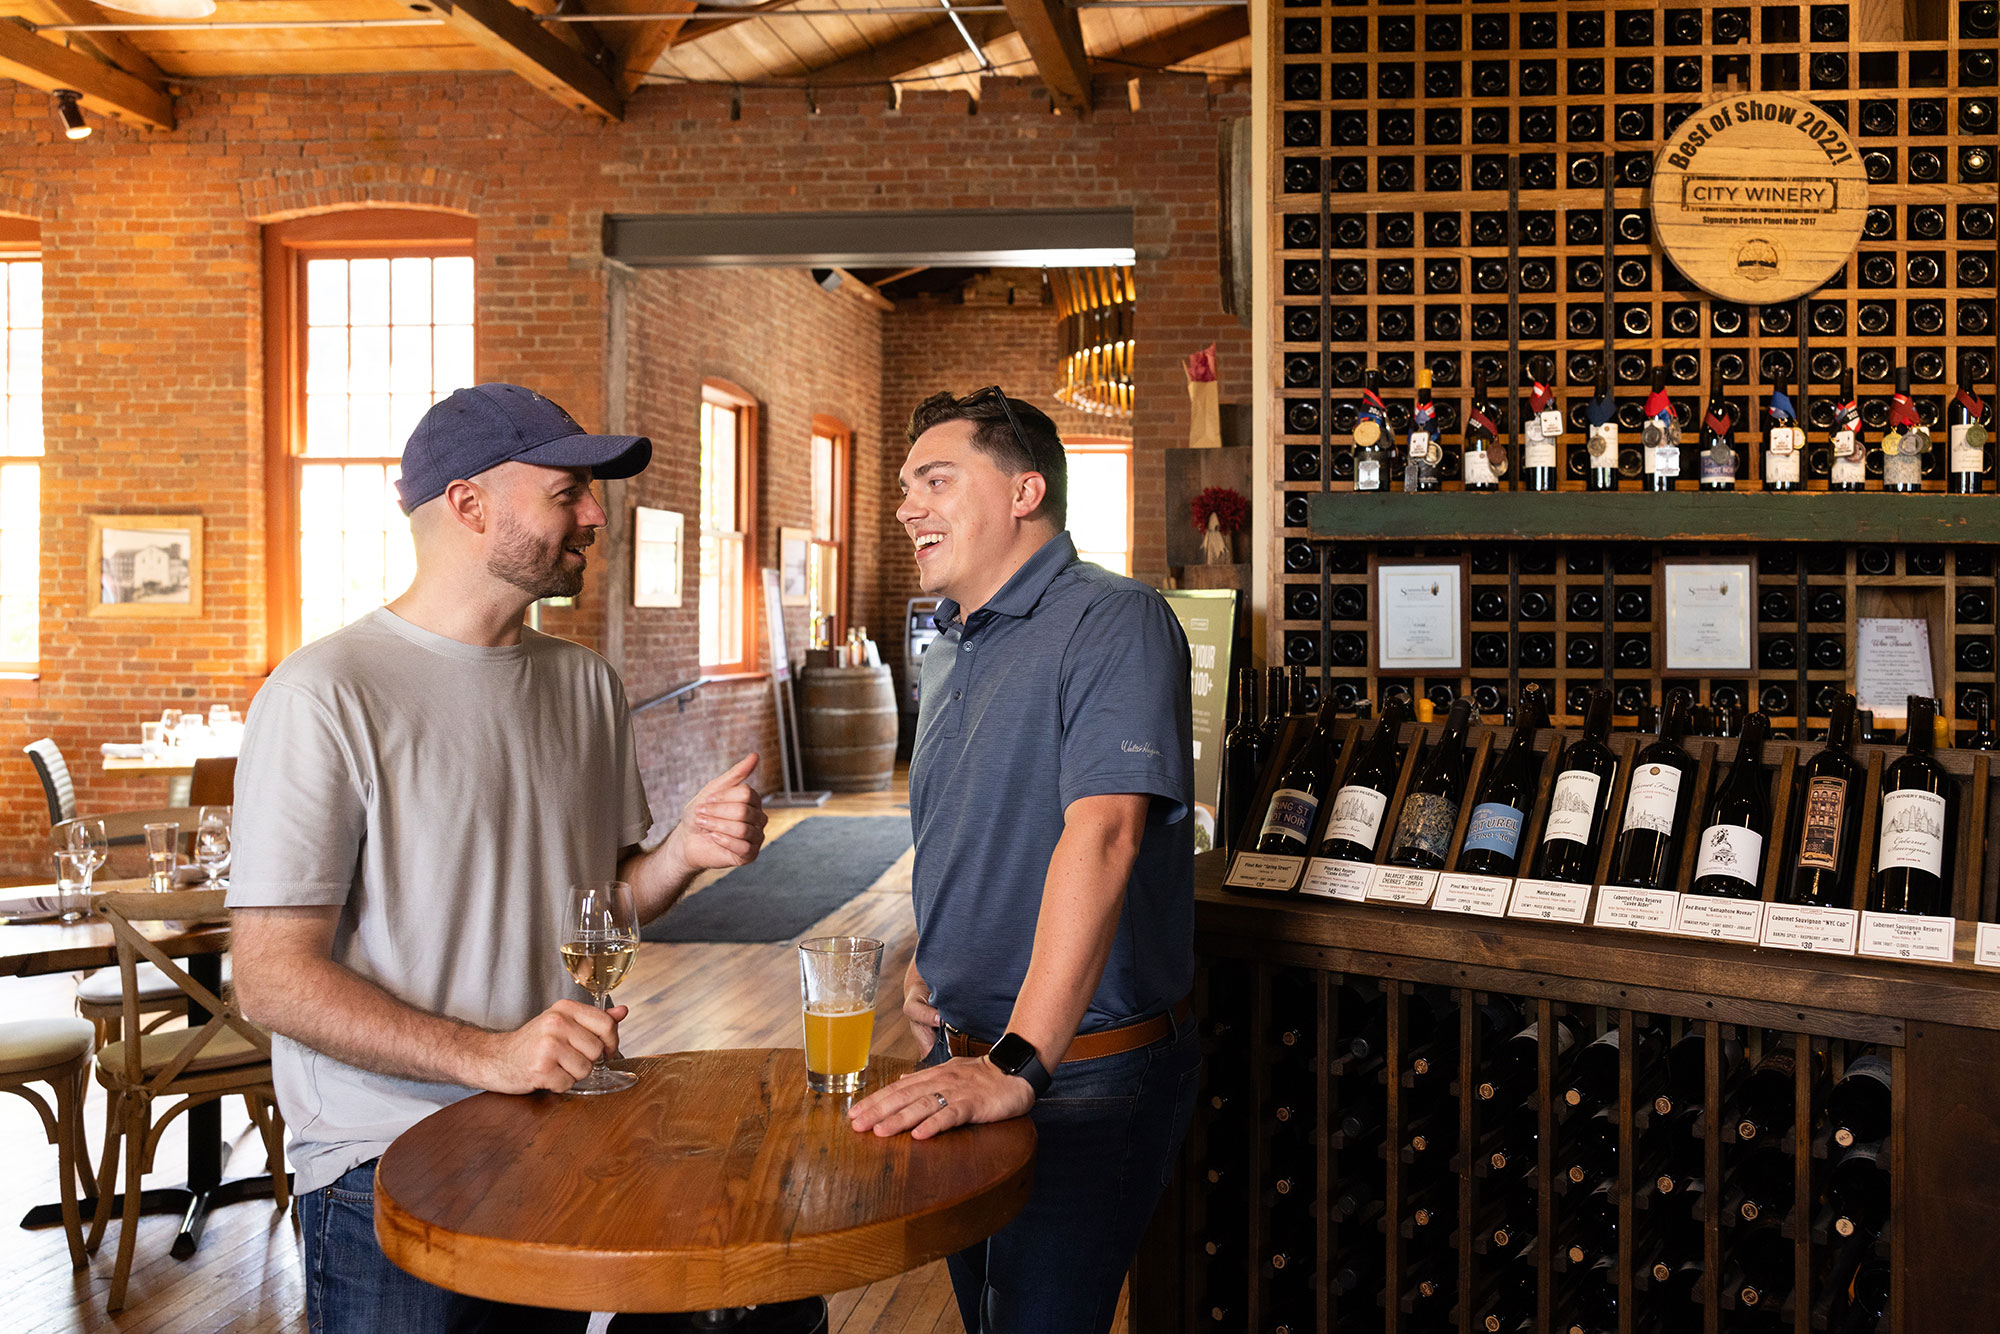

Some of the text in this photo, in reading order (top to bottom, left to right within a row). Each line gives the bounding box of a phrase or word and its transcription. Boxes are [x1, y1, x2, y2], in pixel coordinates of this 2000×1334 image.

[1668, 100, 1853, 170] Best of Show 2022!
[1694, 186, 1826, 202] CITY WINERY
[1702, 216, 1738, 225] Signature
[1195, 644, 1215, 669] YOUR
[1919, 795, 1941, 805] RESERVE
[1284, 814, 1306, 828] NOIR
